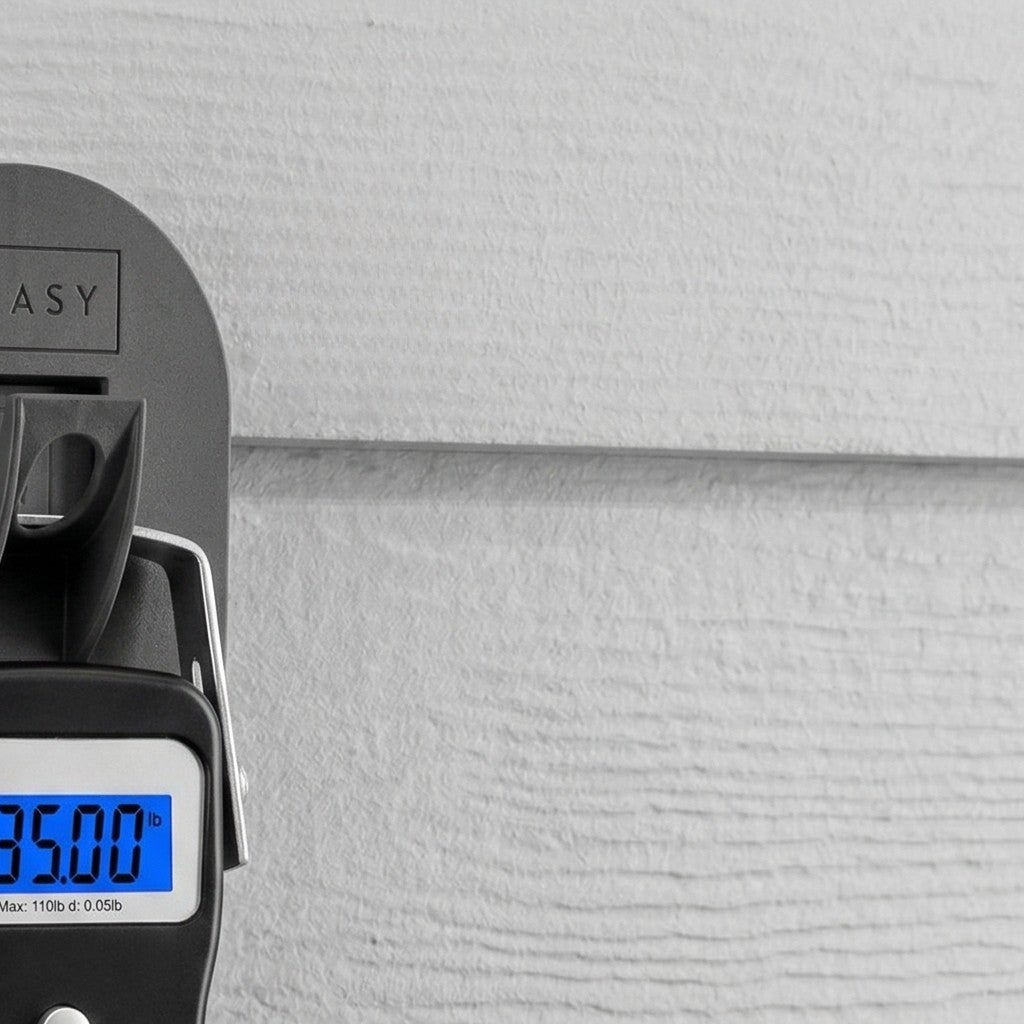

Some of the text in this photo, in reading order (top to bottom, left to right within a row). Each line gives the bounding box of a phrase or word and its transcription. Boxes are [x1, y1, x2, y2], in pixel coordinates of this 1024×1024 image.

[148, 812, 162, 827] lb
[32, 899, 65, 913] 110lb
[68, 899, 80, 912] d:
[83, 899, 123, 912] 0.05lb
